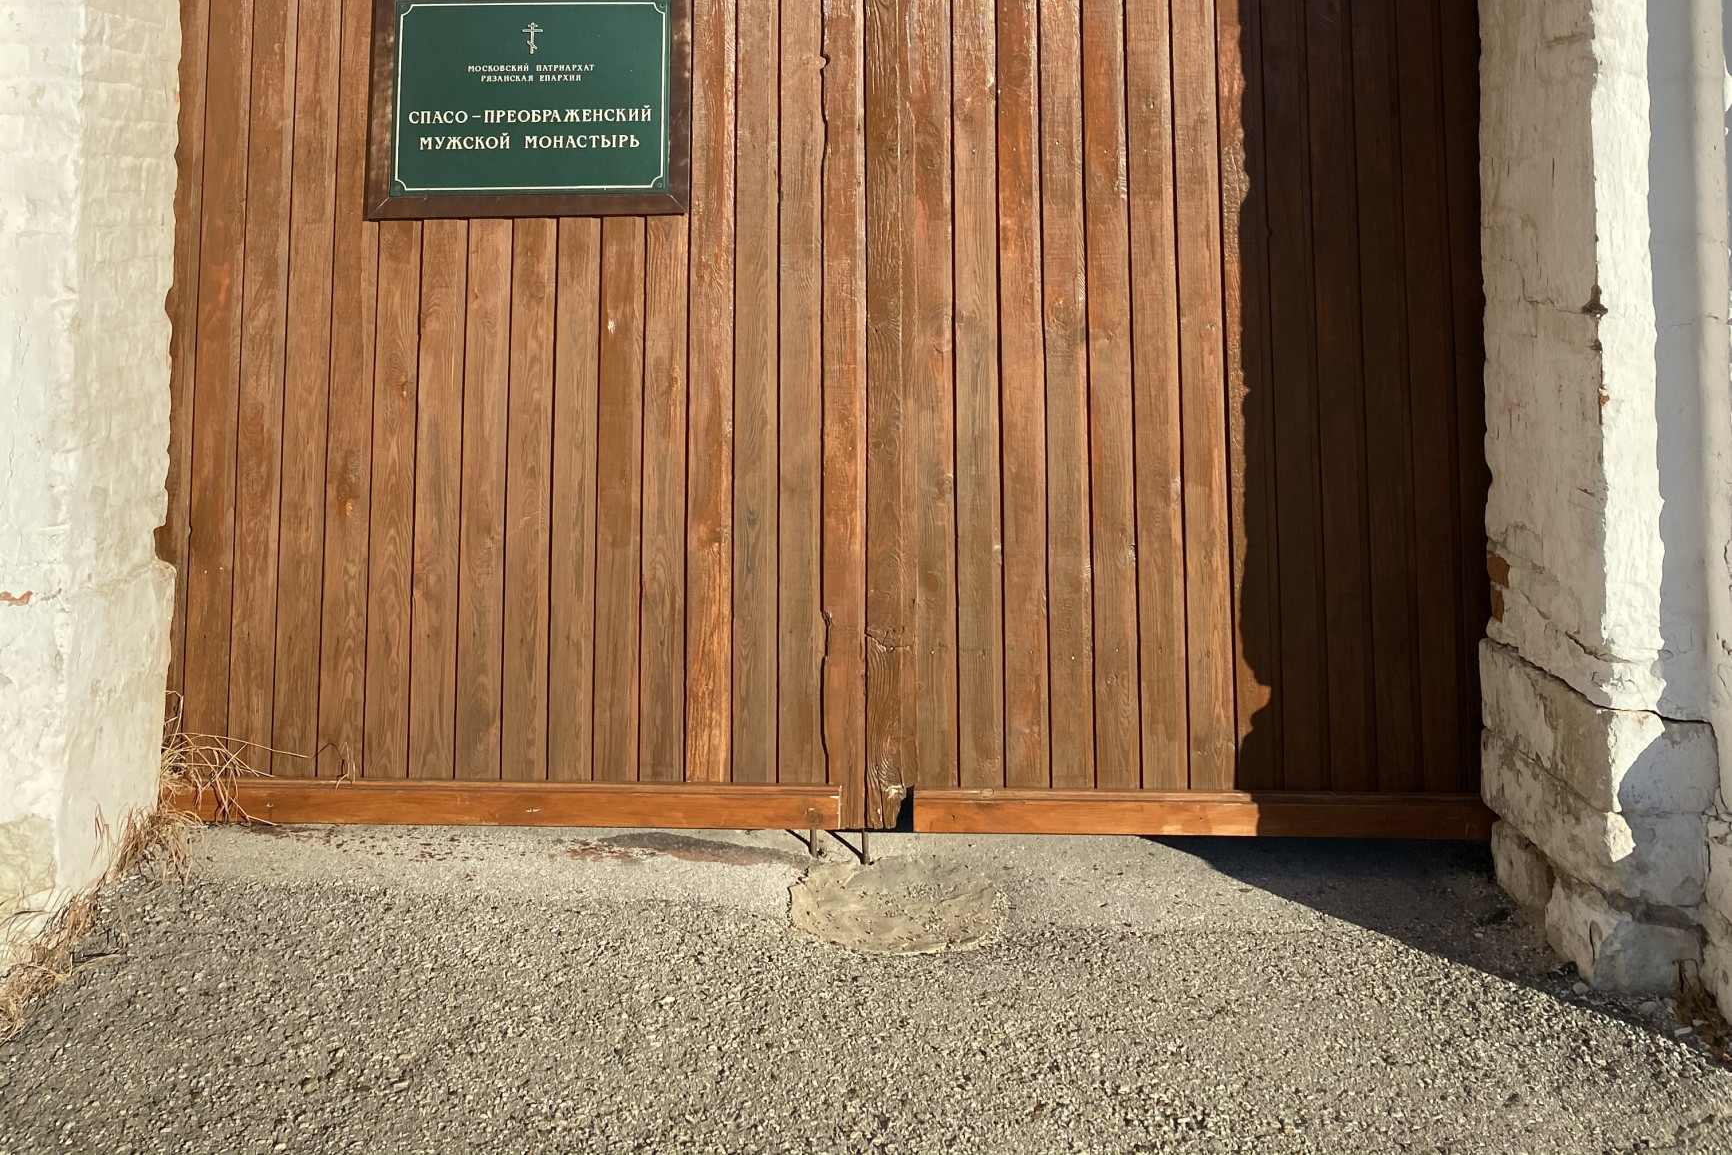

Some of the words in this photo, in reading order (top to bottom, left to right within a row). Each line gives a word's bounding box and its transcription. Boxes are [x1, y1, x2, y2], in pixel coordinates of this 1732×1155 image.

[467, 63, 530, 73] МОСКОВСКИЙ
[536, 63, 595, 72] ПАТРИАРХАТ
[480, 74, 534, 82] РЯЗАНСКАЯ
[539, 73, 582, 82] ЕПАРХИЯ
[419, 132, 511, 150] МУЖСКОЙ
[524, 134, 640, 149] МОНАСТЫРЬ
